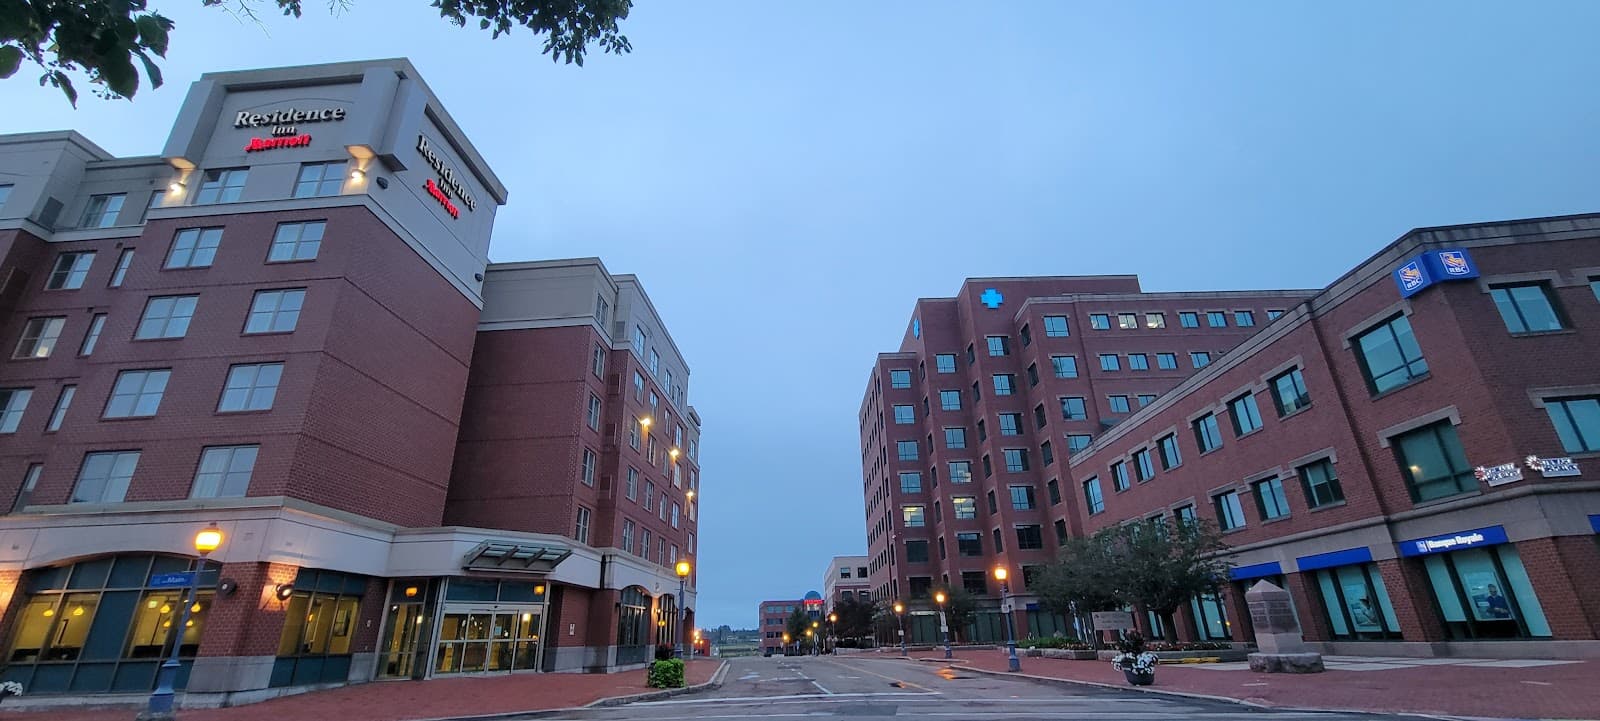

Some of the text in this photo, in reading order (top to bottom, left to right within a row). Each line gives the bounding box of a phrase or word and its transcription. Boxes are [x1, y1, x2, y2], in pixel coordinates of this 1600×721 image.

[233, 107, 346, 127] Residence
[271, 125, 297, 136] Inn
[417, 134, 477, 211] Residence
[439, 178, 453, 199] Inn
[1406, 278, 1420, 288] RBC
[1455, 532, 1484, 545] Royale
